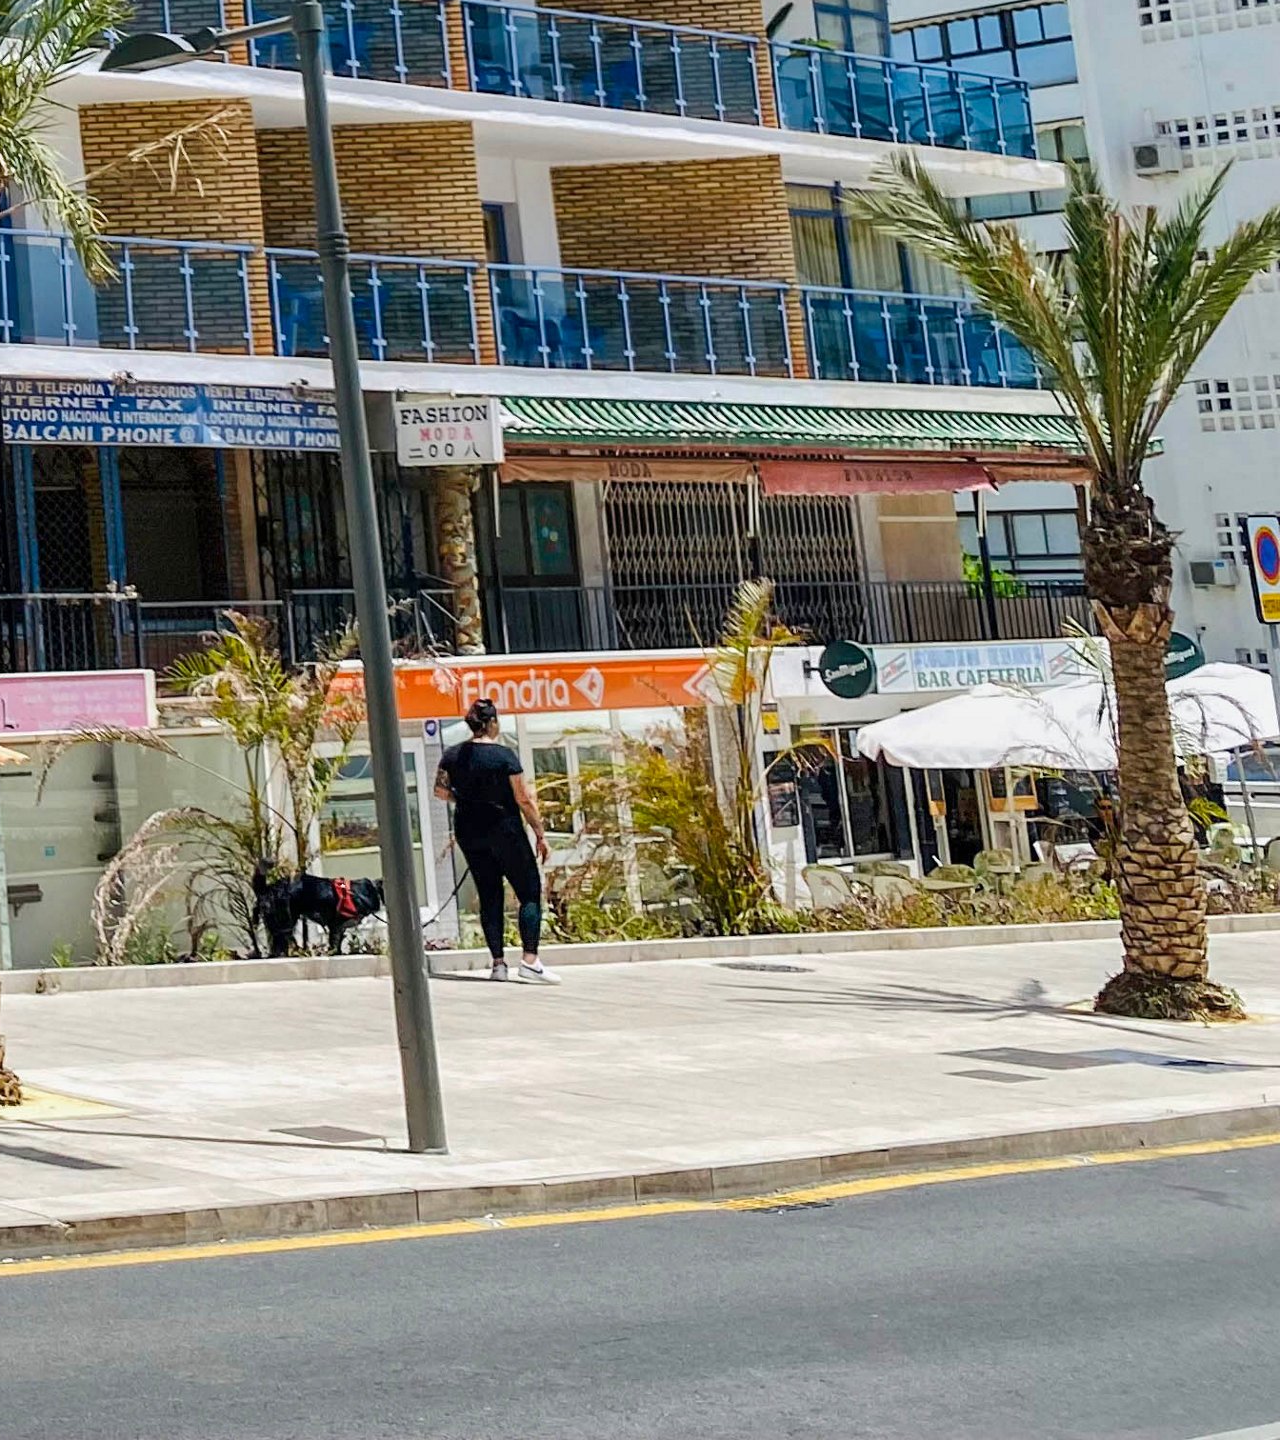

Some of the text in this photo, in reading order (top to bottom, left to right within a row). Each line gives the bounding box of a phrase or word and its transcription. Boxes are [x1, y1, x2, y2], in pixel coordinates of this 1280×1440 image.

[16, 381, 33, 393] DE
[36, 382, 104, 396] TELEFONIA
[136, 399, 183, 411] FAX
[213, 399, 303, 415] INTERNET
[318, 405, 338, 417] FA
[61, 411, 111, 424] NACIONAL
[113, 411, 121, 424] E
[205, 413, 266, 427] LOCUTORIO
[400, 405, 488, 425] FASHION
[2, 423, 94, 441] BALCANI
[101, 426, 177, 443] PHONE
[225, 427, 290, 446] BALCANI
[419, 426, 474, 441] MODA
[608, 461, 652, 478] MODA
[917, 666, 1045, 688] BAR CAFETERIA
[462, 667, 571, 712] Flandria
